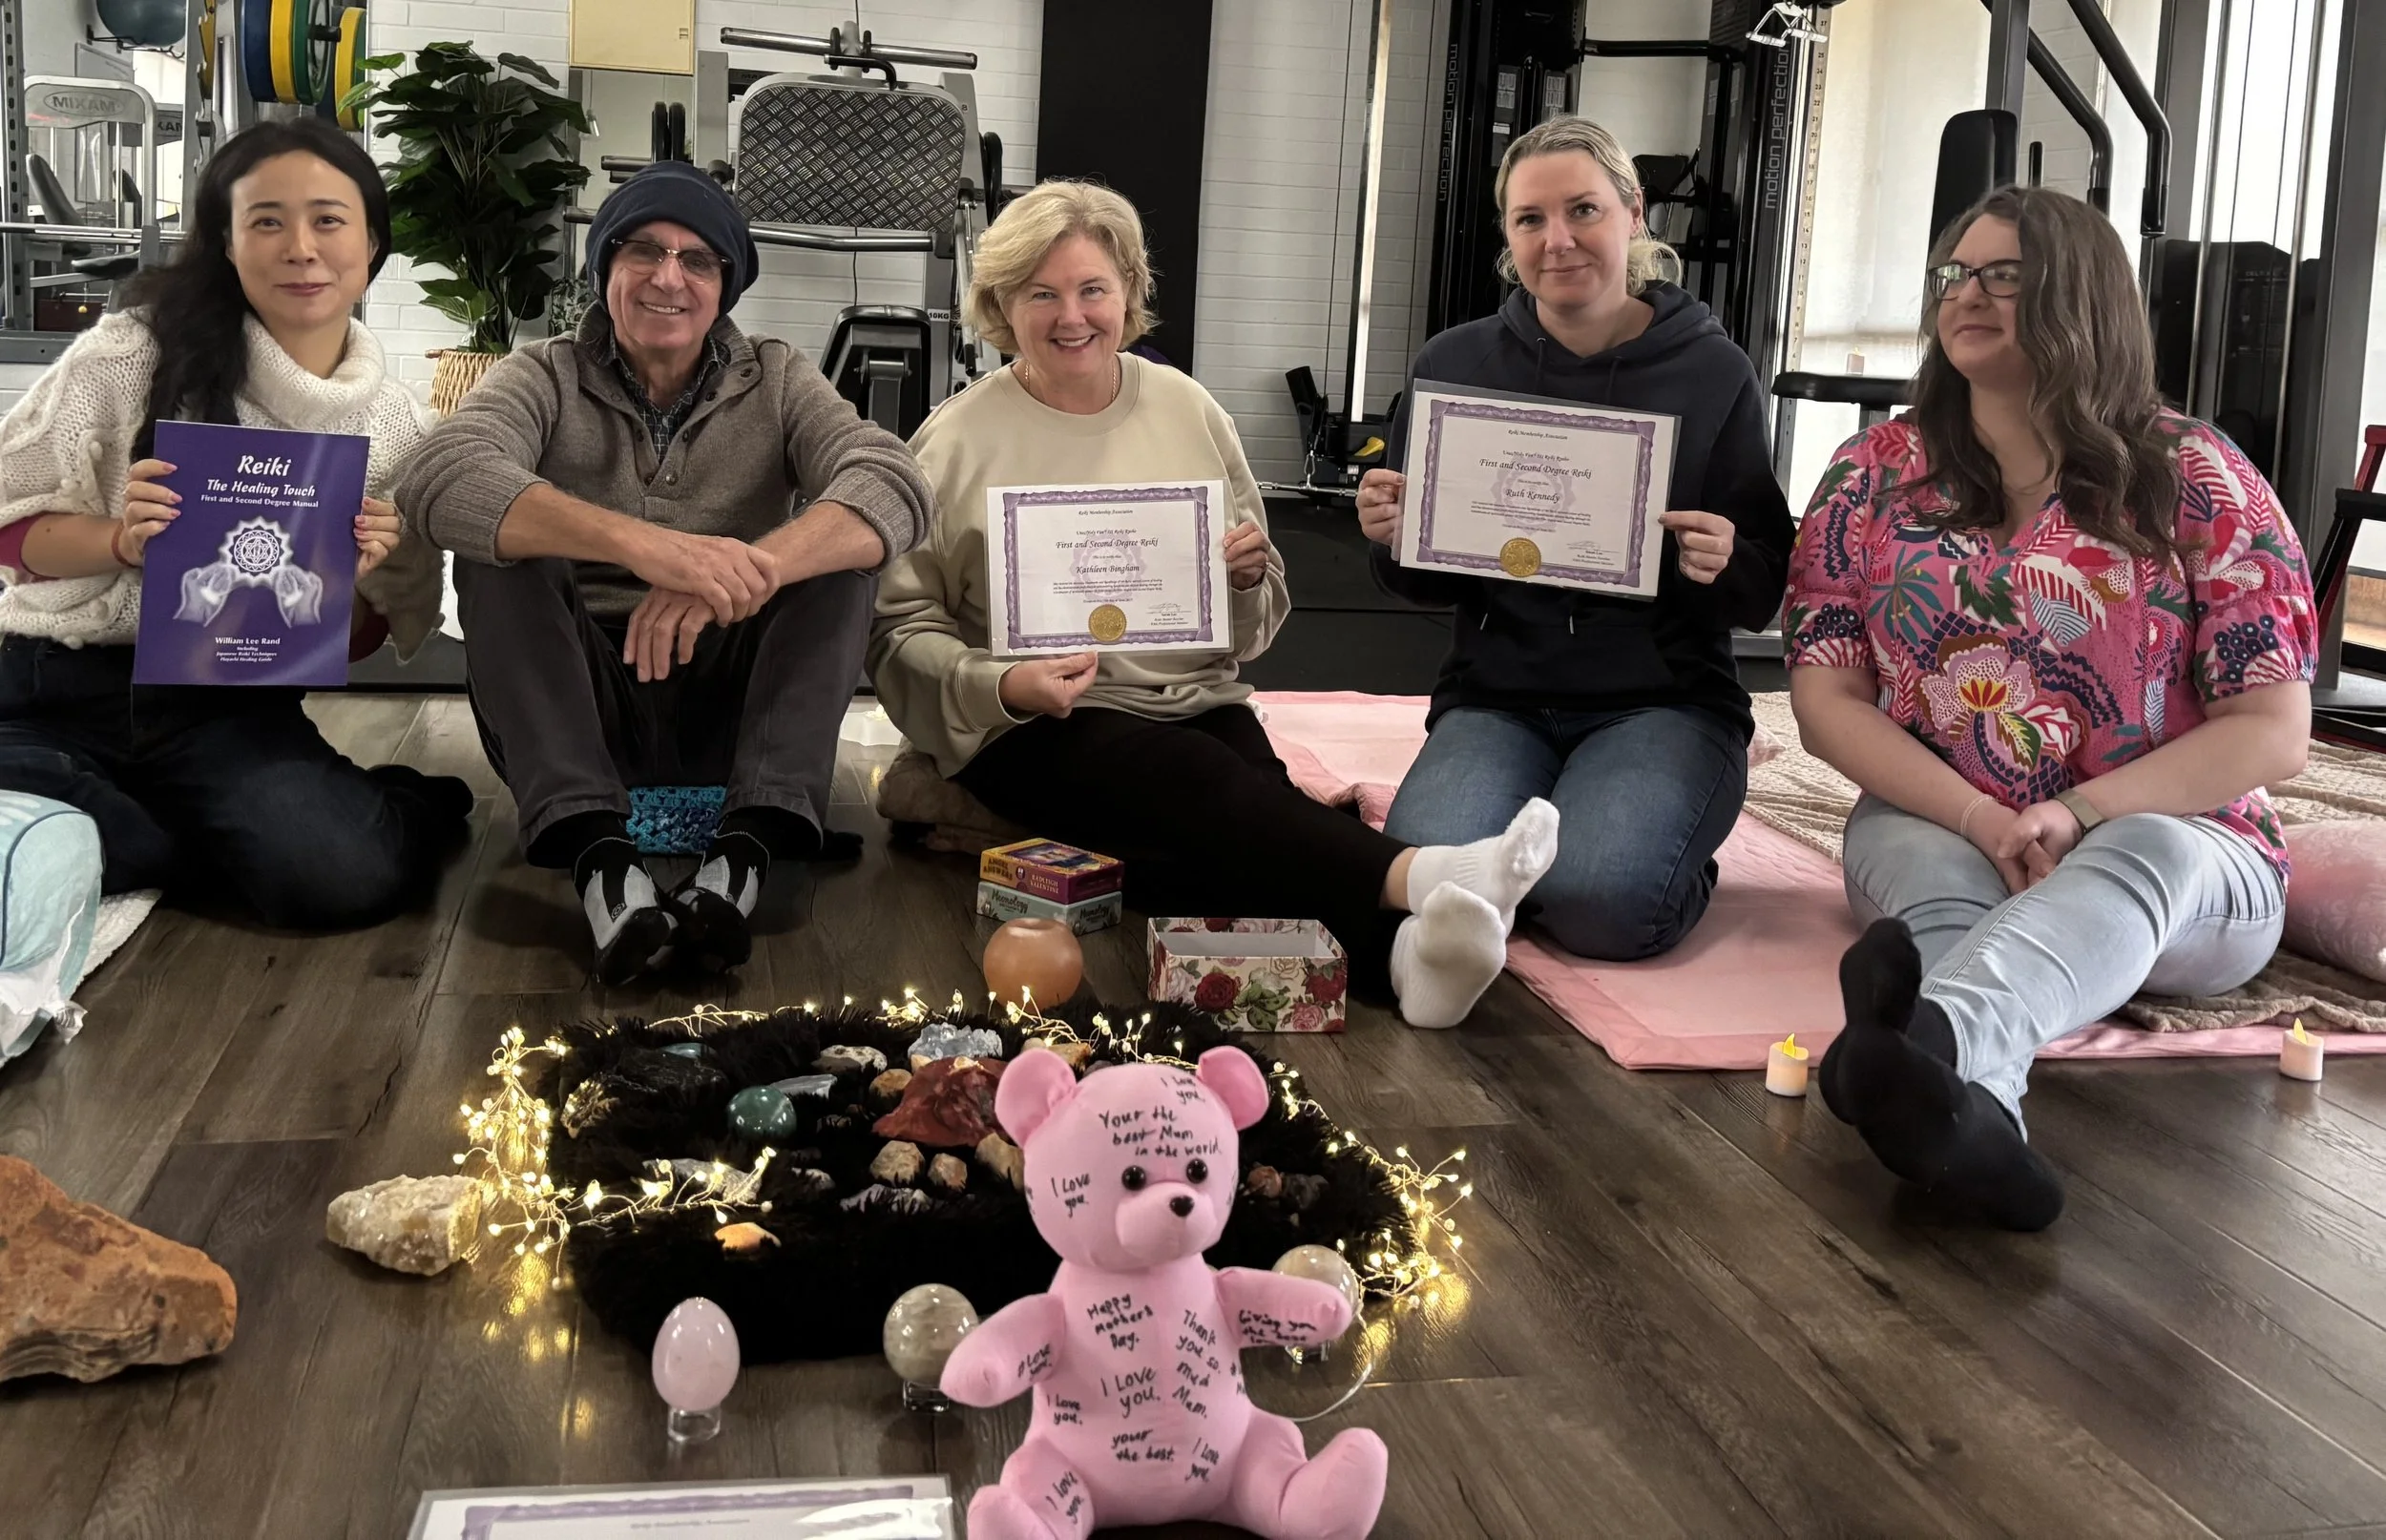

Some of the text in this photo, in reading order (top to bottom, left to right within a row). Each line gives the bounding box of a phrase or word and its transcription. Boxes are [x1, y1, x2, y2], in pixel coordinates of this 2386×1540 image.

[1764, 145, 1781, 209] motion
[238, 454, 292, 476] Reiki
[1479, 458, 1592, 479] First and Second Degree Reiki
[207, 478, 316, 497] The Healing Touch
[1505, 489, 1560, 504] Ruth Kennedy
[235, 496, 262, 506] Second
[264, 498, 290, 508] Degree
[1056, 537, 1159, 550] First and Second Degree Reiki
[1076, 564, 1140, 574] Kathleen Bingham
[215, 636, 243, 645] William
[1030, 880, 1058, 894] VALENTINE
[1099, 1105, 1177, 1129] Your the
[1135, 1147, 1148, 1155] in
[1155, 1144, 1178, 1157] the
[1051, 1177, 1058, 1198] I
[1086, 1293, 1132, 1321] Happy
[1183, 1309, 1217, 1346] Thank
[1175, 1335, 1204, 1359] you
[1100, 1377, 1108, 1398] I
